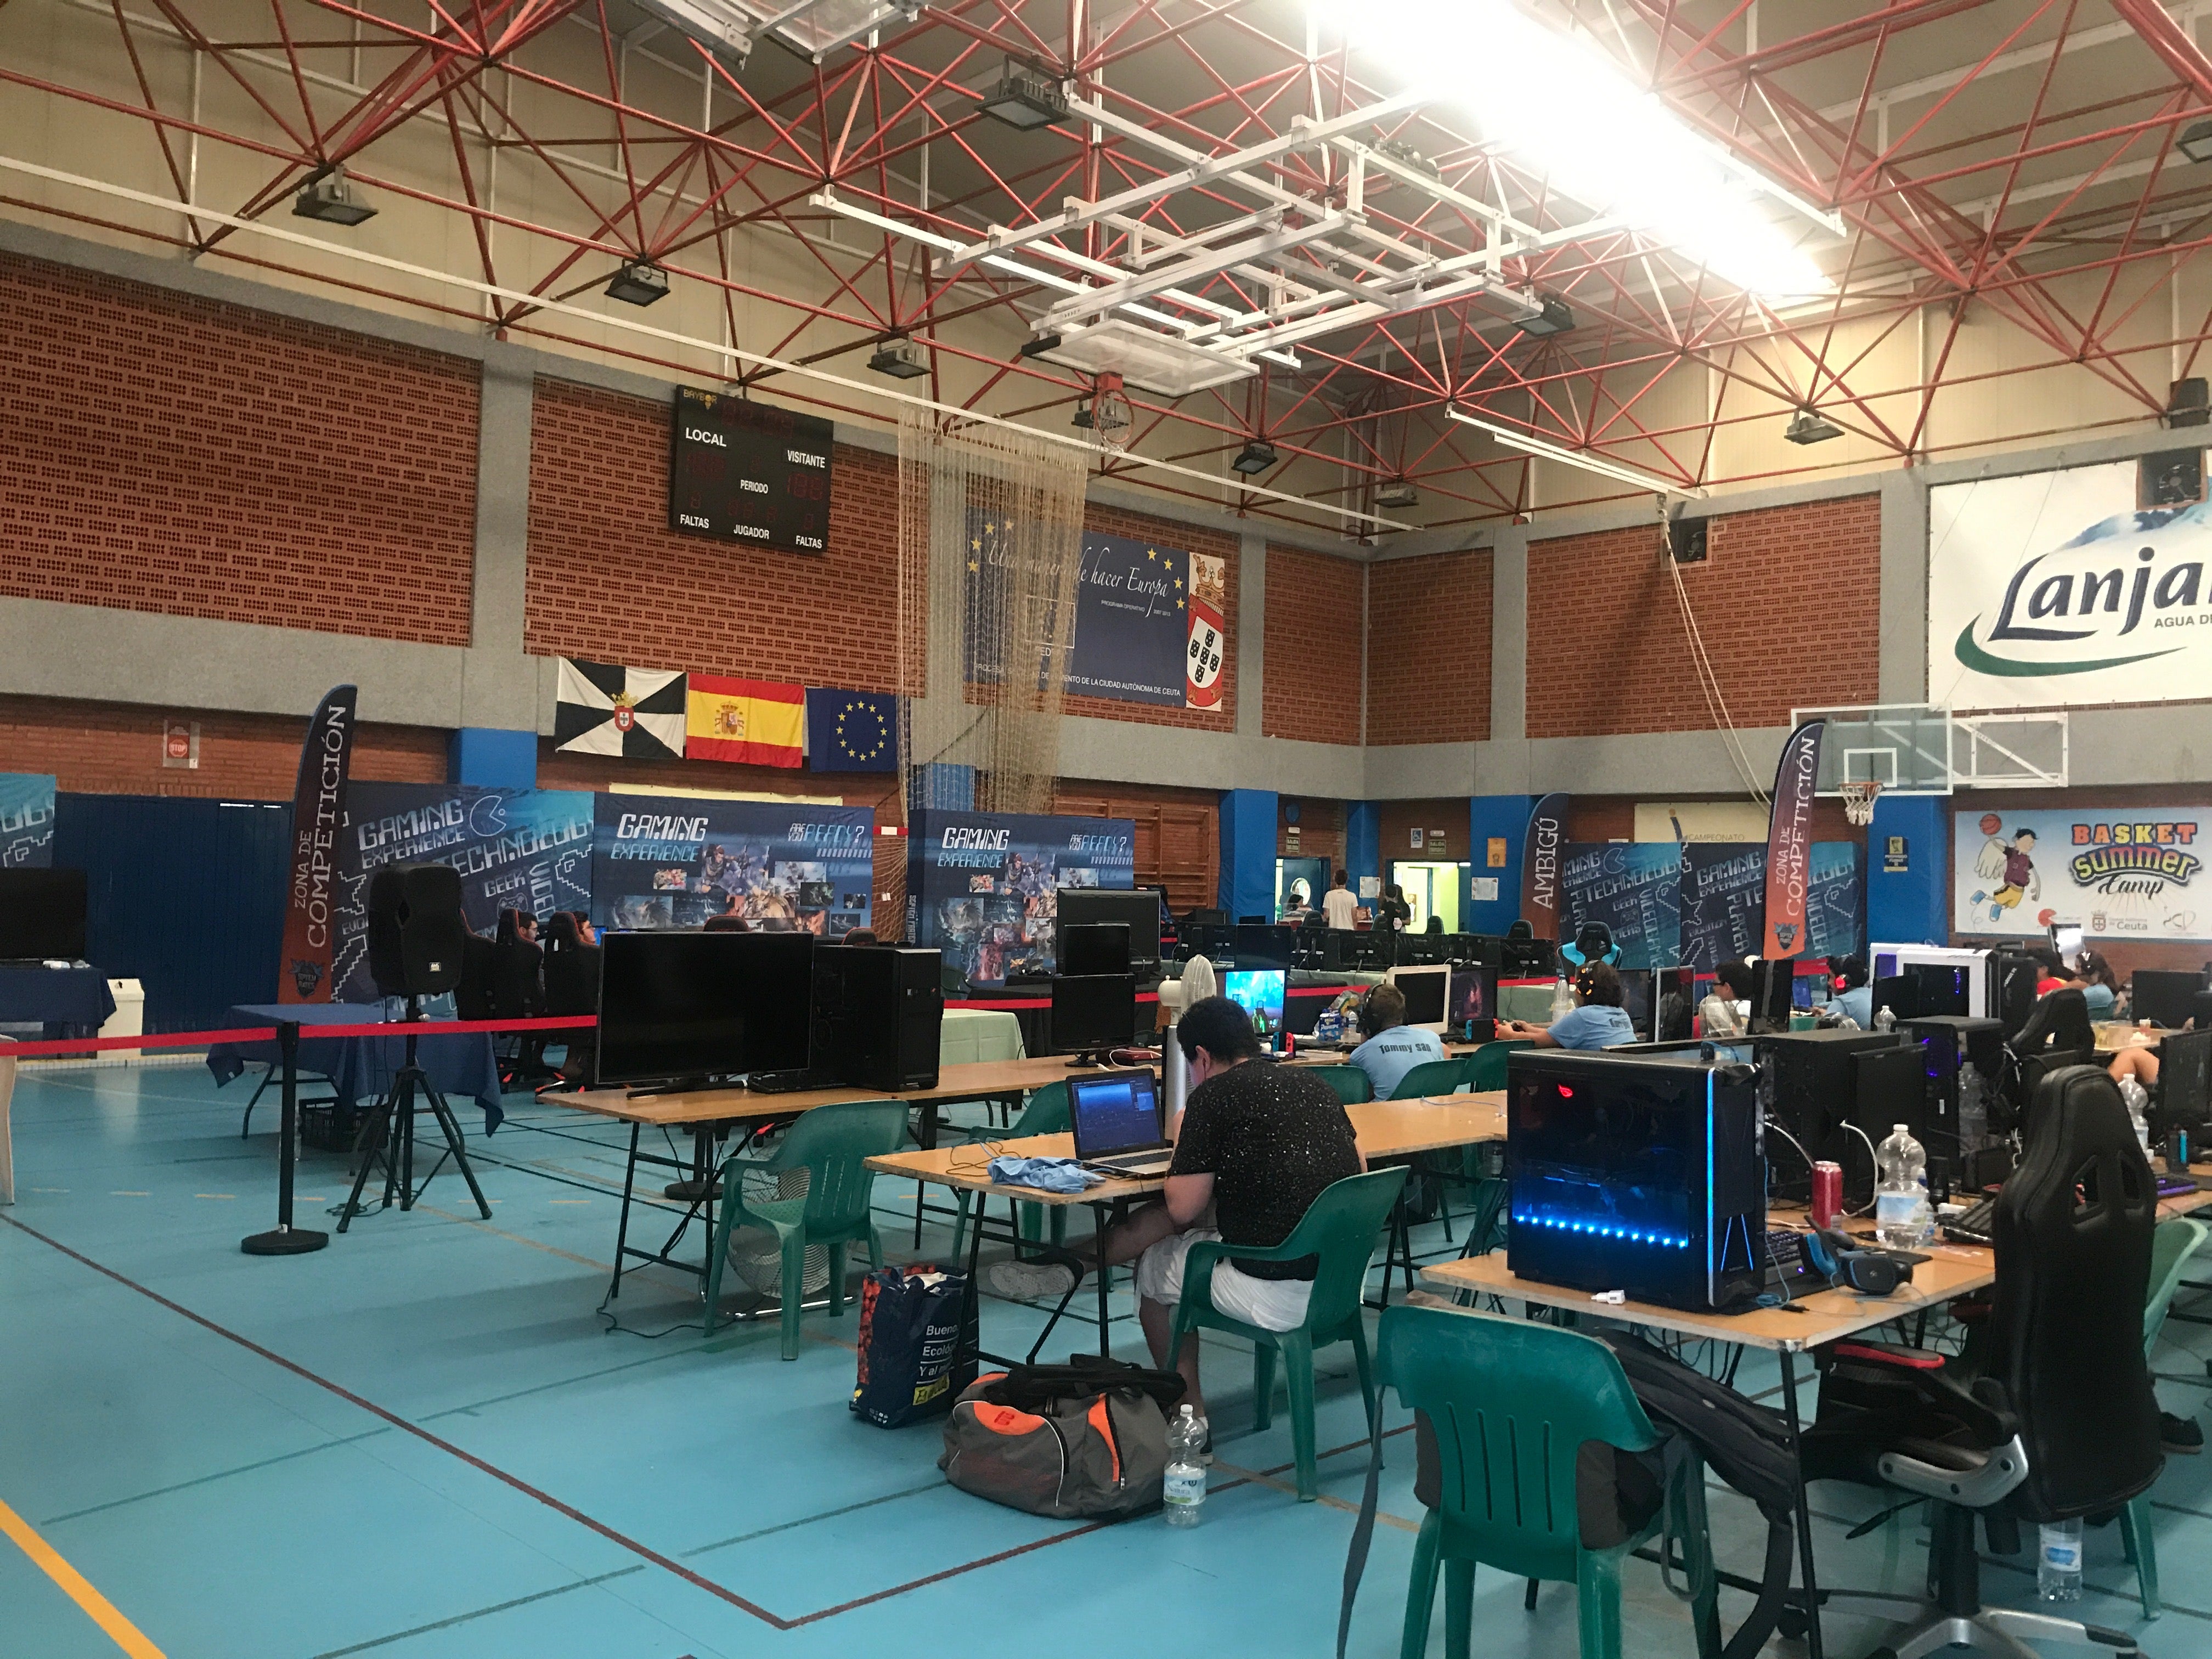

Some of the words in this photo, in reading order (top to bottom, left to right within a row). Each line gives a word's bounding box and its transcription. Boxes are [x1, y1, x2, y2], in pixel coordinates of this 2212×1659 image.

[686, 427, 727, 447] LOCAL
[787, 449, 826, 469] VISITANTE
[741, 479, 768, 494] PERIODO
[680, 514, 709, 529] FALTAS
[733, 524, 770, 540] JUGADOR
[796, 535, 822, 549] FALTAS
[1090, 548, 1124, 588] hacer
[1127, 567, 1169, 618] Europa
[1987, 546, 2212, 642] Lanja
[2154, 614, 2195, 628] AGUA
[2199, 614, 2212, 624] D
[1081, 676, 1090, 685] DE
[1099, 679, 1121, 689] CIUDAD
[1121, 682, 1153, 693] AUTÓNOMA
[1162, 687, 1181, 697] CEUTA
[307, 704, 347, 947] COMPETICIÓN
[358, 798, 464, 851] GAMING
[617, 814, 709, 842] GAMING
[789, 823, 806, 832] ARE
[1779, 826, 1791, 845] DE
[1786, 736, 1816, 917] COMPETICIÓN
[2072, 822, 2198, 845] BASKET
[298, 830, 312, 855] DE
[361, 825, 466, 869] EXPERIENCE
[788, 832, 804, 842] YOU
[942, 827, 1010, 850] GAMING
[1069, 842, 1081, 851] YOU
[1070, 834, 1082, 843] ARE
[611, 843, 700, 862] EXPERIENCE
[938, 853, 1003, 868] EXPERIENCE
[1532, 817, 1559, 910] AMBIGÚ
[1562, 851, 1601, 877] MING
[1697, 851, 1761, 886] GAMING
[1776, 848, 1789, 885] ZONA
[295, 861, 308, 909] ZONA
[484, 870, 526, 898] GEEK
[1699, 871, 1762, 898] EXPERIENCE
[2098, 874, 2164, 900] Camp
[1726, 893, 1750, 954] PLAYER
[2117, 922, 2148, 930] Ceuta
[1379, 1045, 1413, 1053] Tommy
